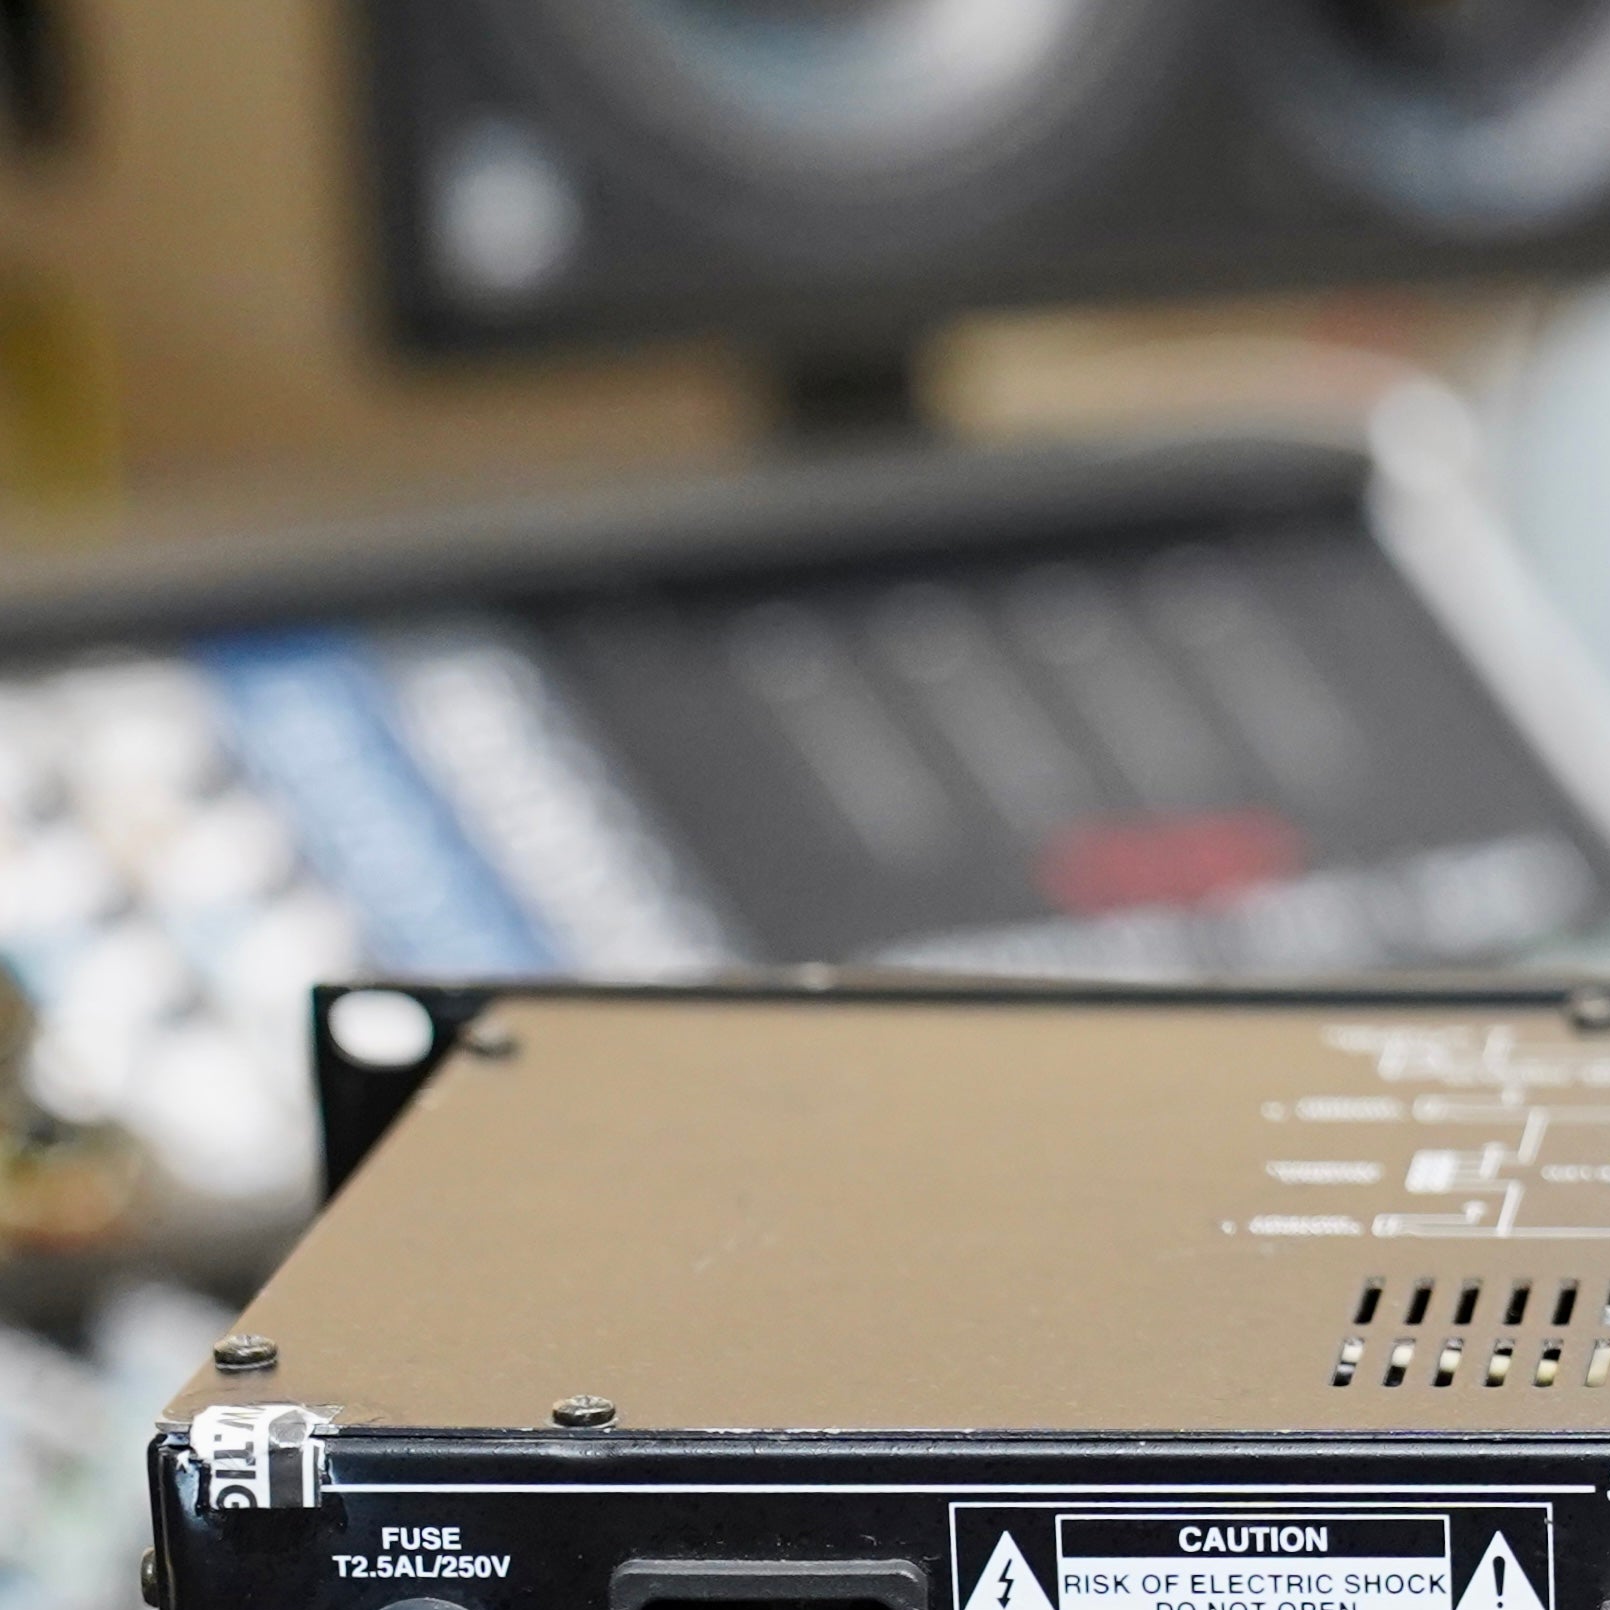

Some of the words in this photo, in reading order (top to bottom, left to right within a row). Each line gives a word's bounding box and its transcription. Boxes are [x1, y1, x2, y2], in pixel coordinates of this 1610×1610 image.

[382, 1527, 461, 1550] FUSE
[1179, 1526, 1328, 1552] CAUTION
[332, 1555, 510, 1578] T2.5AL/250V
[1065, 1575, 1129, 1594] RISK
[1142, 1574, 1178, 1594] OF
[1191, 1574, 1332, 1594] ELECTRIC
[1345, 1574, 1445, 1594] SHOCK
